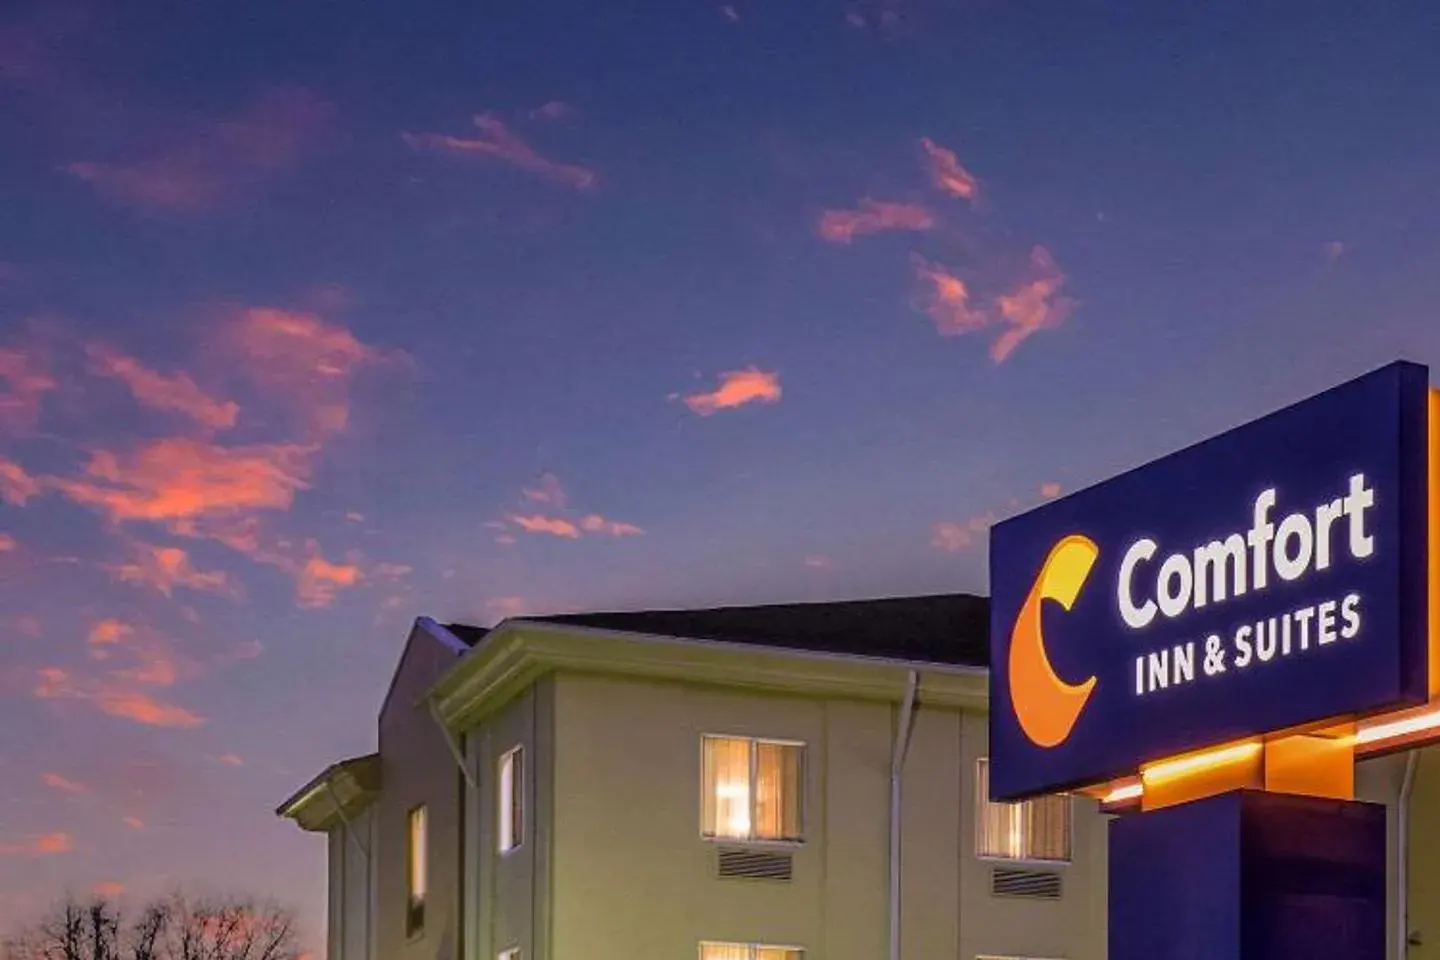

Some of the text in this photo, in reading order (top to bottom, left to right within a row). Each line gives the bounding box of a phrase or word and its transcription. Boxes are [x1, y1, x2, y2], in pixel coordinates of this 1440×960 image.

[1117, 473, 1374, 629] Comfort
[1136, 593, 1361, 695] INN & SUITES
